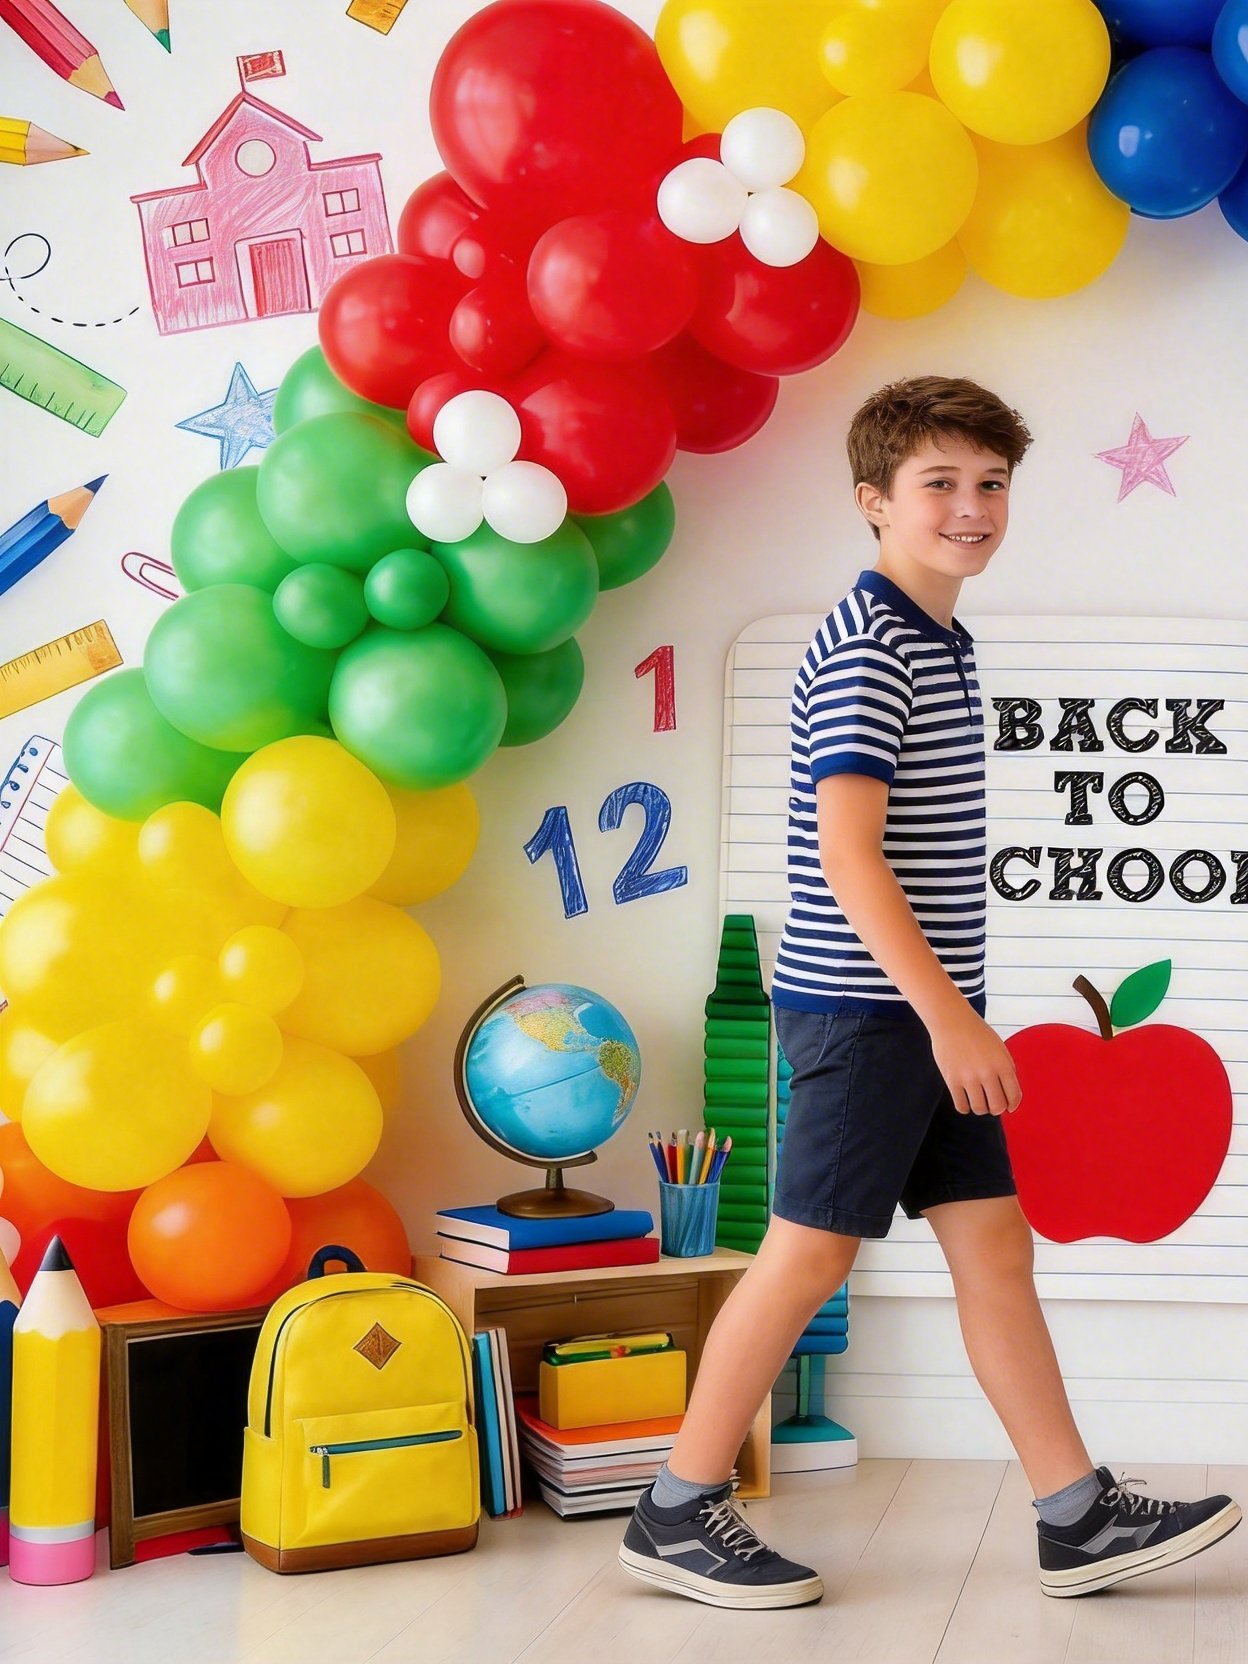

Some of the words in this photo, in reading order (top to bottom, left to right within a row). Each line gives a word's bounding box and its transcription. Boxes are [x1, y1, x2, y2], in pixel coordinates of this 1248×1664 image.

[634, 645, 677, 732] 1
[990, 697, 1227, 754] BACK
[1054, 771, 1165, 826] TO
